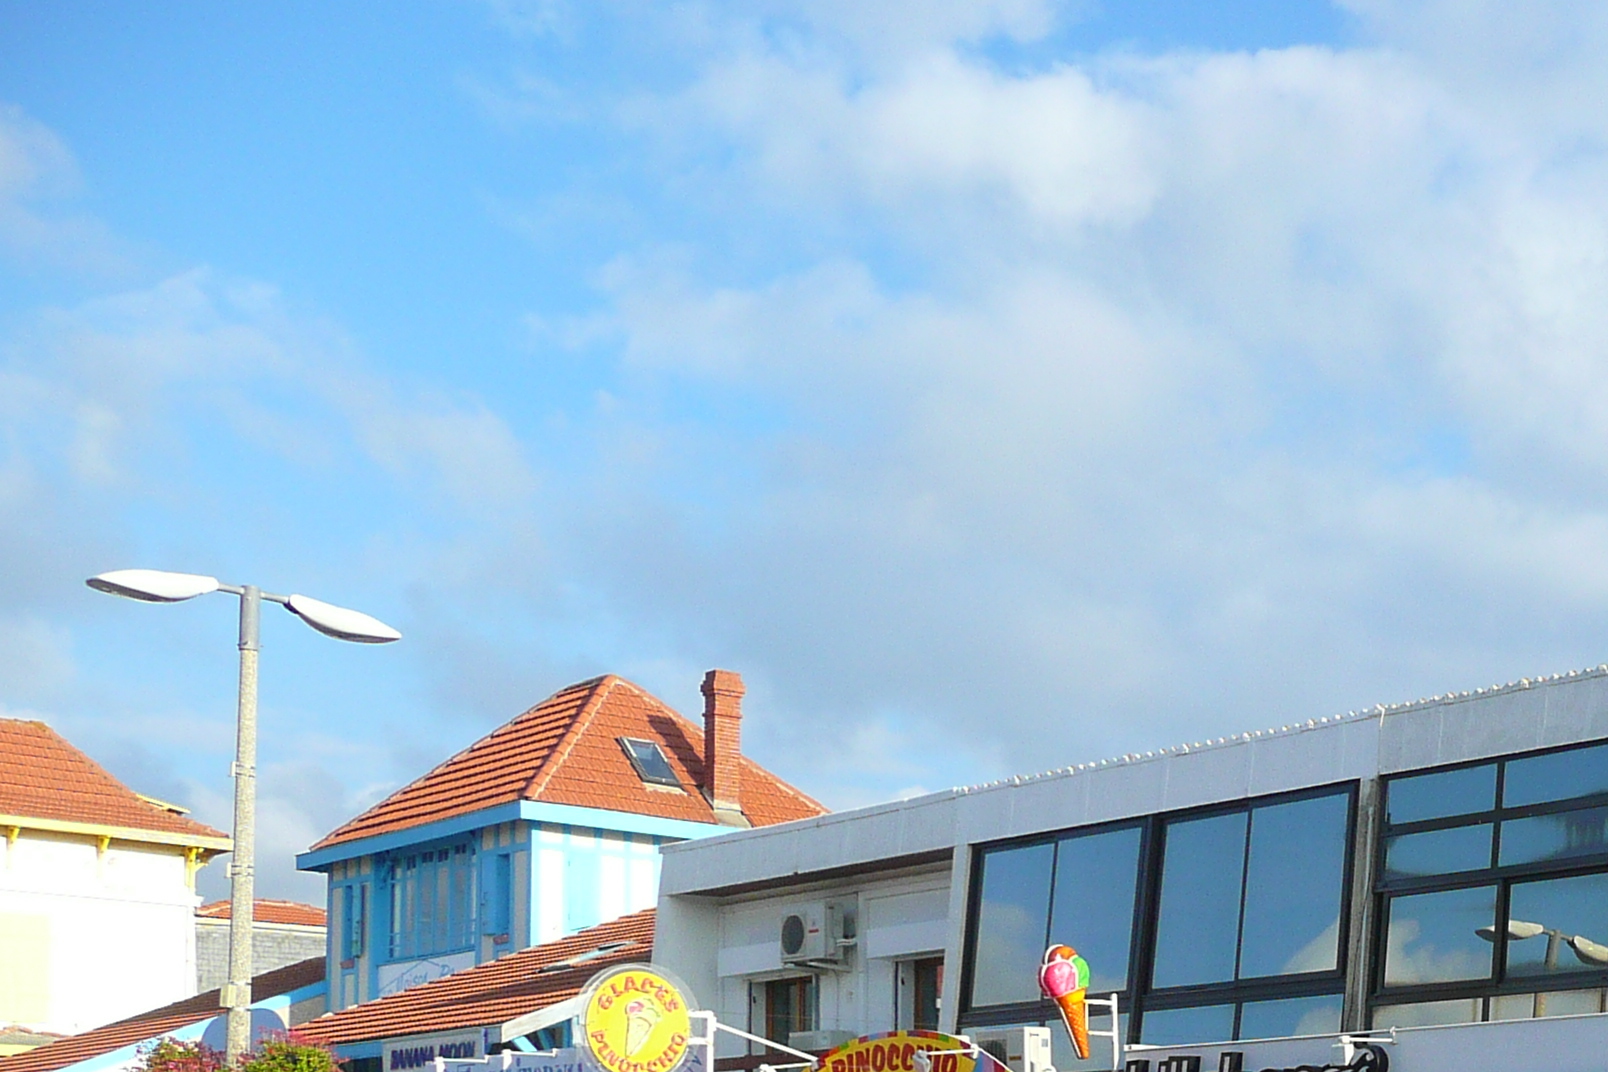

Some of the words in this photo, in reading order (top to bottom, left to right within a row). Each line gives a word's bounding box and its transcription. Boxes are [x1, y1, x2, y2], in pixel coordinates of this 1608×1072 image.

[598, 976, 679, 1012] GLACES
[390, 1046, 434, 1070] BANANA
[439, 1041, 475, 1058] MOON
